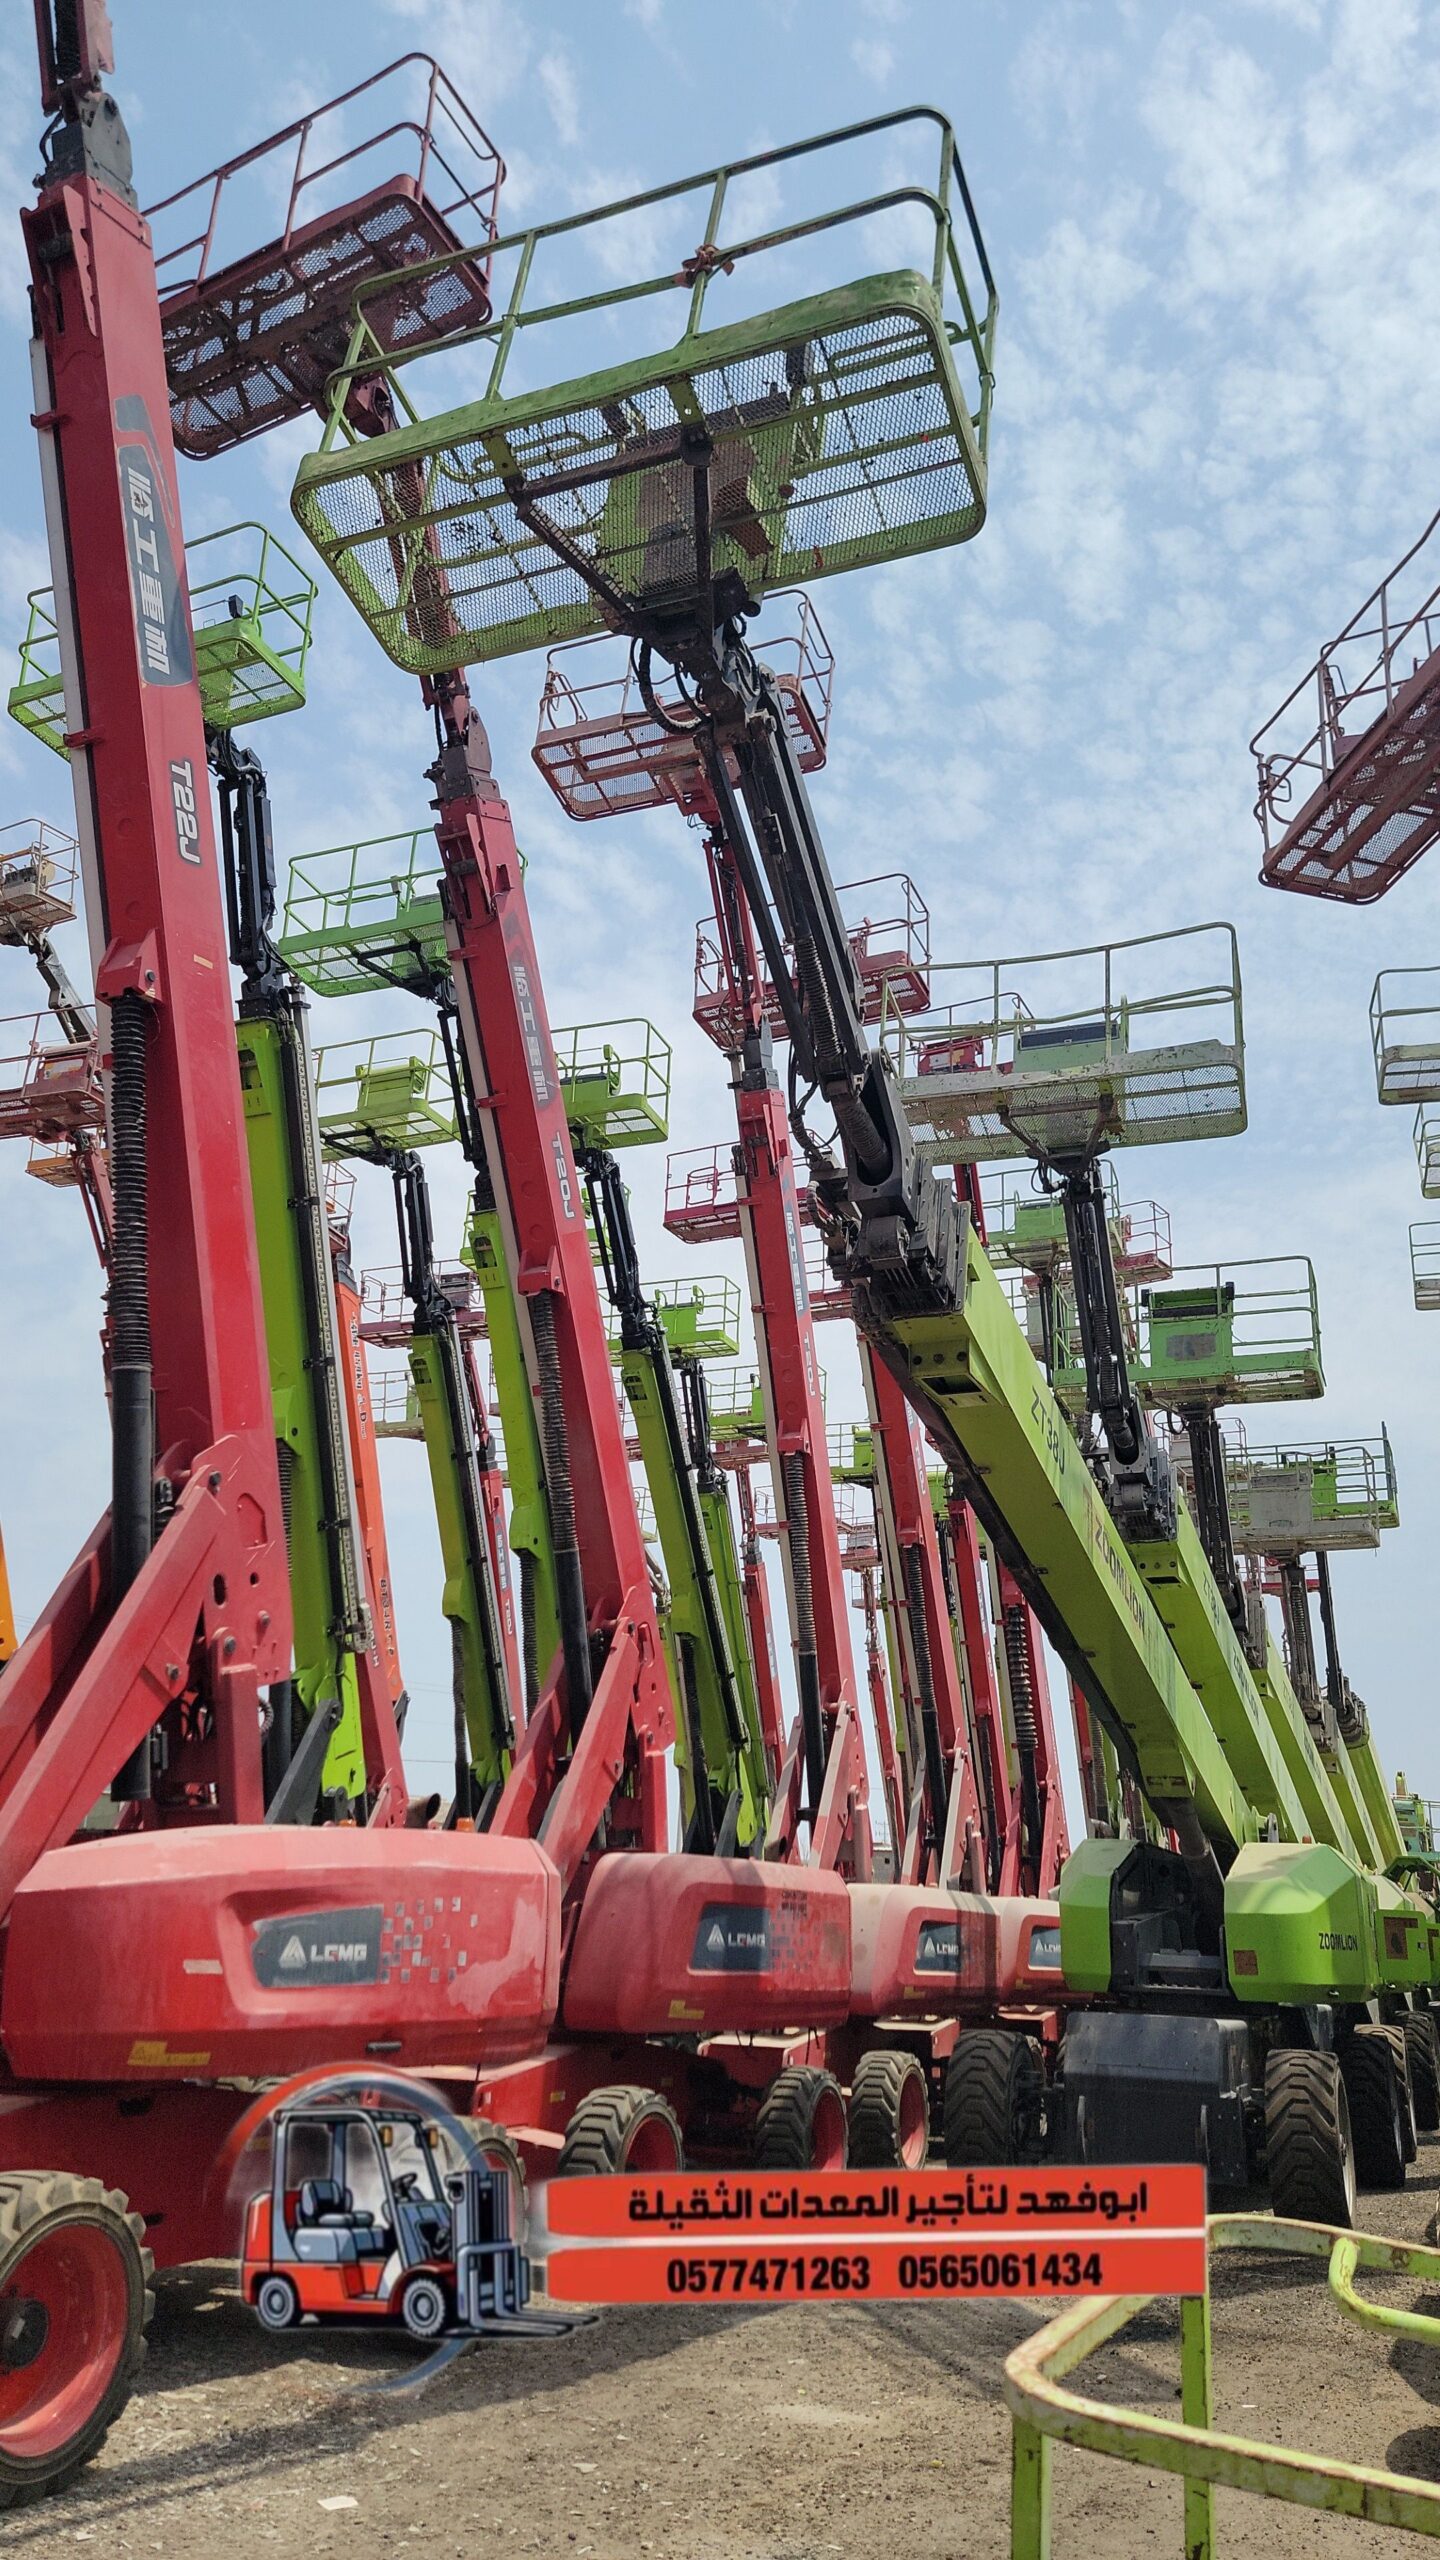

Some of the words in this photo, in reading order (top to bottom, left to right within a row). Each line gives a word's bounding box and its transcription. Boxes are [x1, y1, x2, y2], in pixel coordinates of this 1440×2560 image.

[171, 761, 200, 863] T22J
[551, 1132, 575, 1218] T20J
[1031, 1386, 1065, 1475] ZT38J
[1094, 1511, 1146, 1638] ZOOMLION
[1318, 1933, 1359, 1952] ZOOMLION
